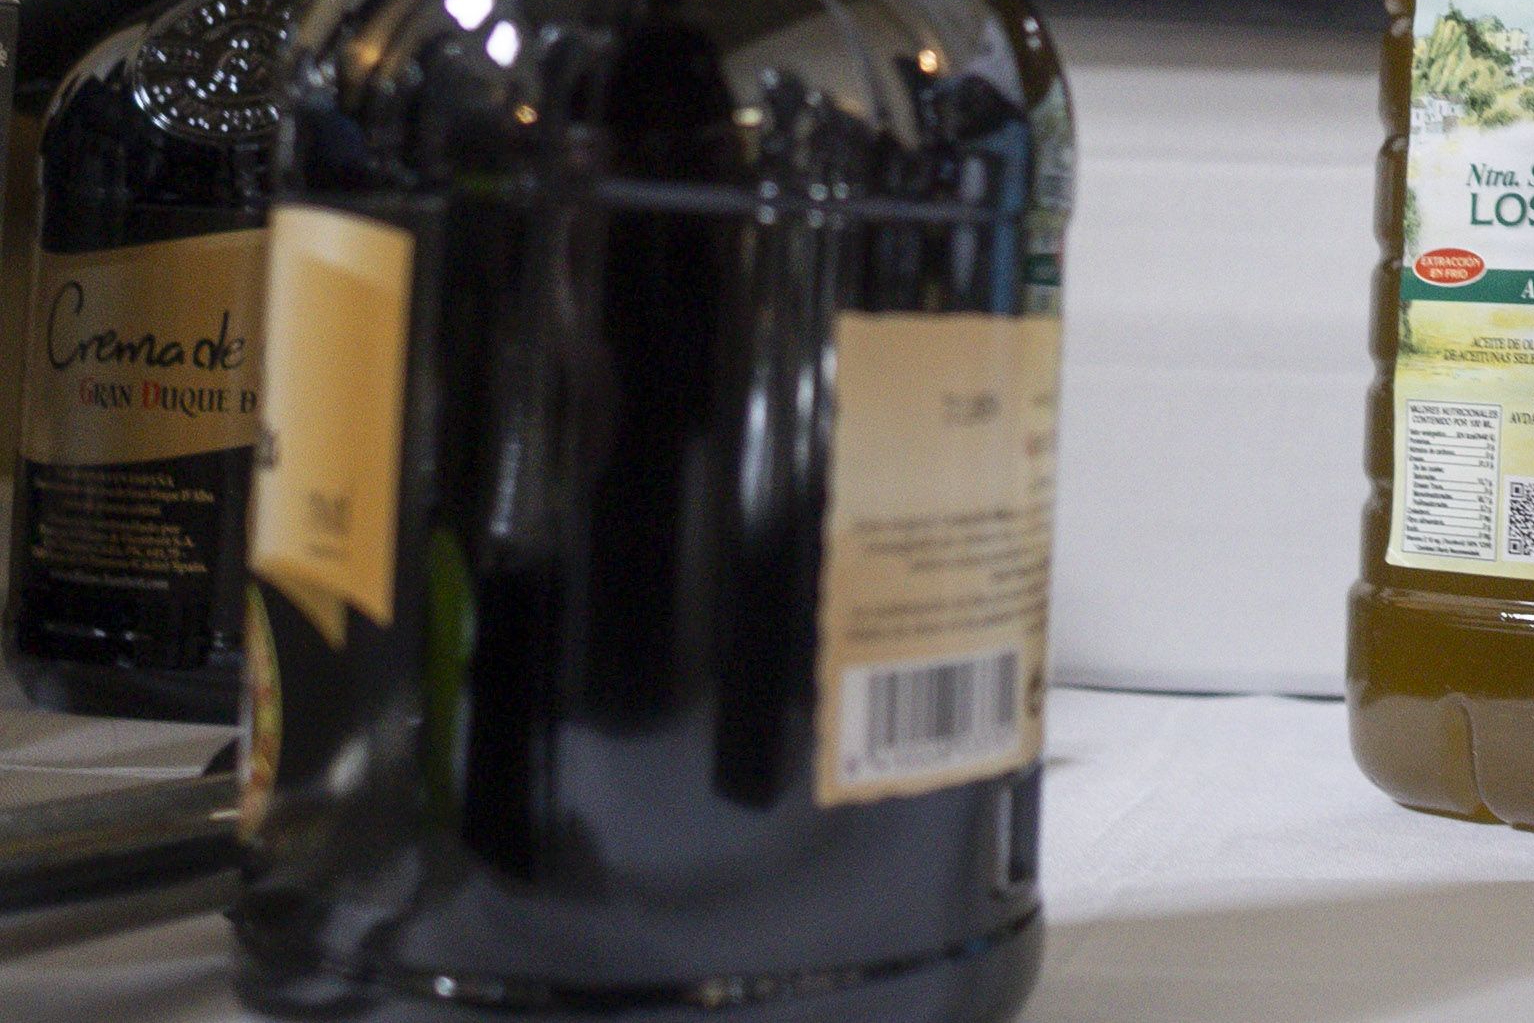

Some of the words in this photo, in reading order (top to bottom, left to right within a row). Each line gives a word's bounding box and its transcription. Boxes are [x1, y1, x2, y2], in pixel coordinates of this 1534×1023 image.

[1466, 162, 1520, 188] Ntra.
[46, 279, 186, 371] Crema
[192, 310, 246, 371] de
[1472, 337, 1506, 349] ACEITE
[1507, 338, 1521, 350] DE
[1460, 351, 1512, 365] ACEITUNAS
[79, 380, 132, 408] GRAN
[141, 379, 229, 418] DUQUE
